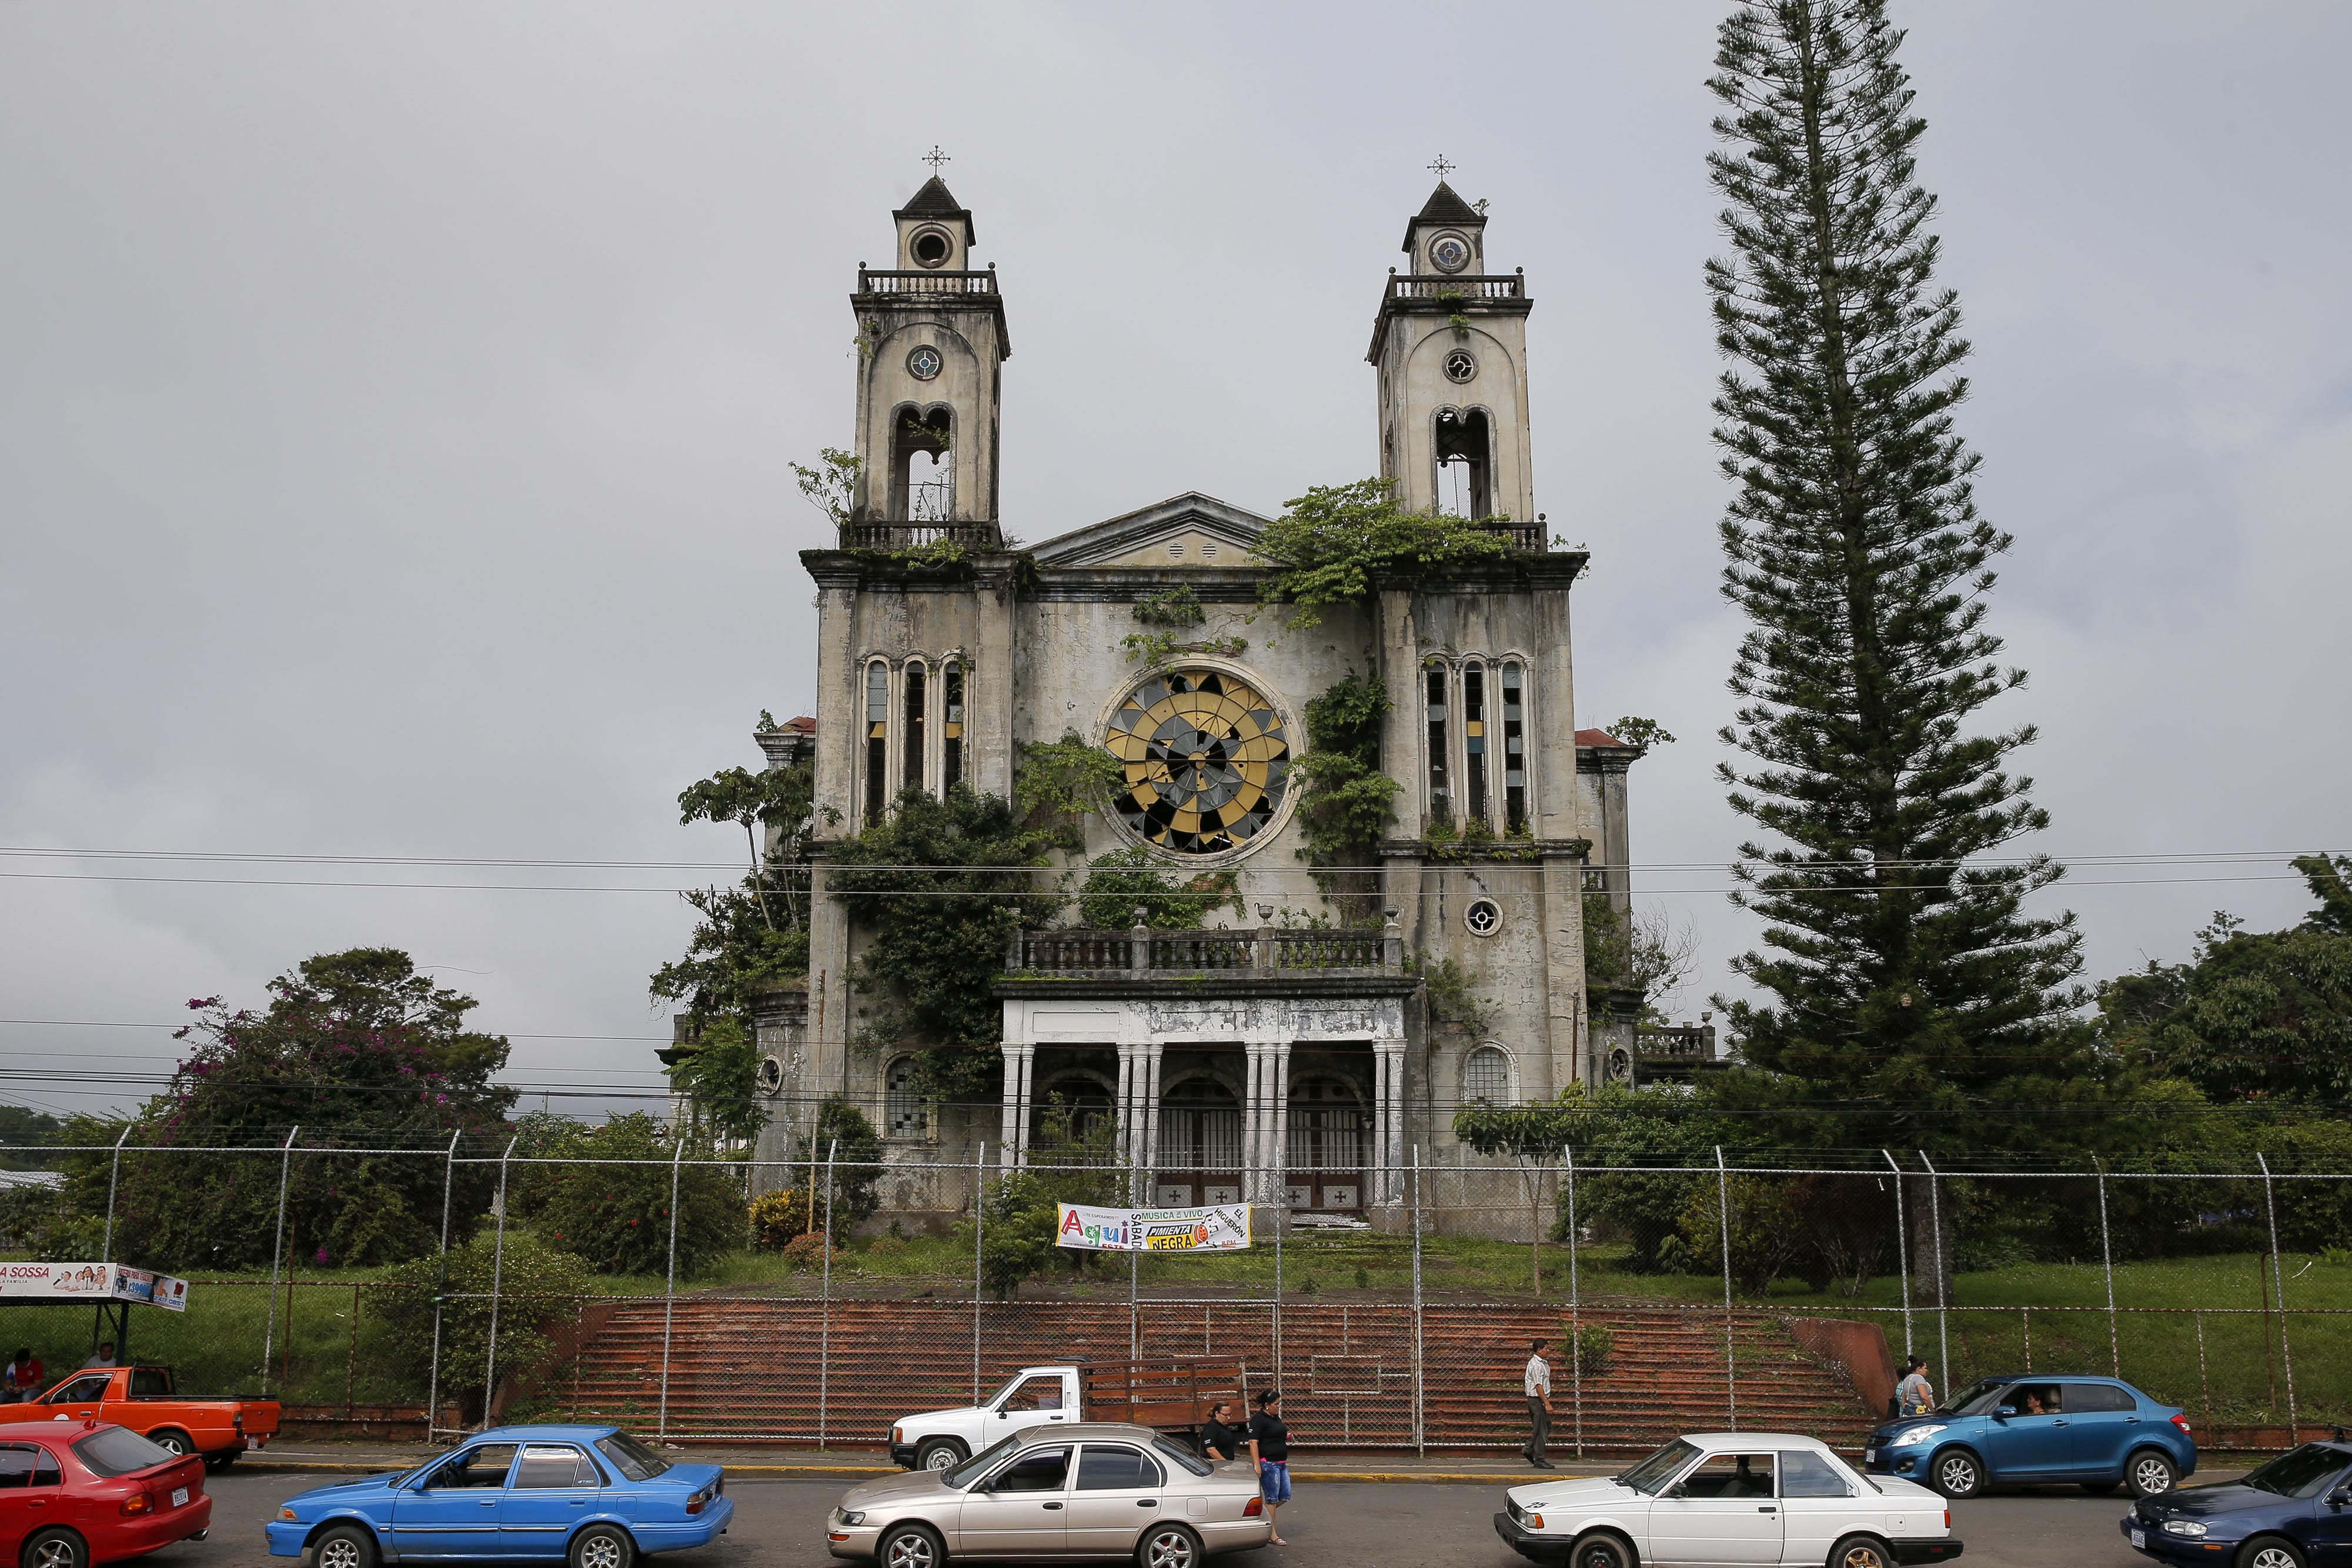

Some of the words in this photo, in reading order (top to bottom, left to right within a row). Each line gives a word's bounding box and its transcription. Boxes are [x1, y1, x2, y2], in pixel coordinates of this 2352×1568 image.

[1141, 1211, 1174, 1220] MUSICA
[1183, 1209, 1203, 1218] VIVO
[1234, 1208, 1243, 1219] EL
[1061, 1210, 1128, 1247] Aqui
[1214, 1208, 1245, 1238] HIGUERÓN
[1150, 1225, 1191, 1236] PIMIENTA
[1153, 1236, 1193, 1250] NEGRA
[9, 1267, 49, 1278] SOSSA
